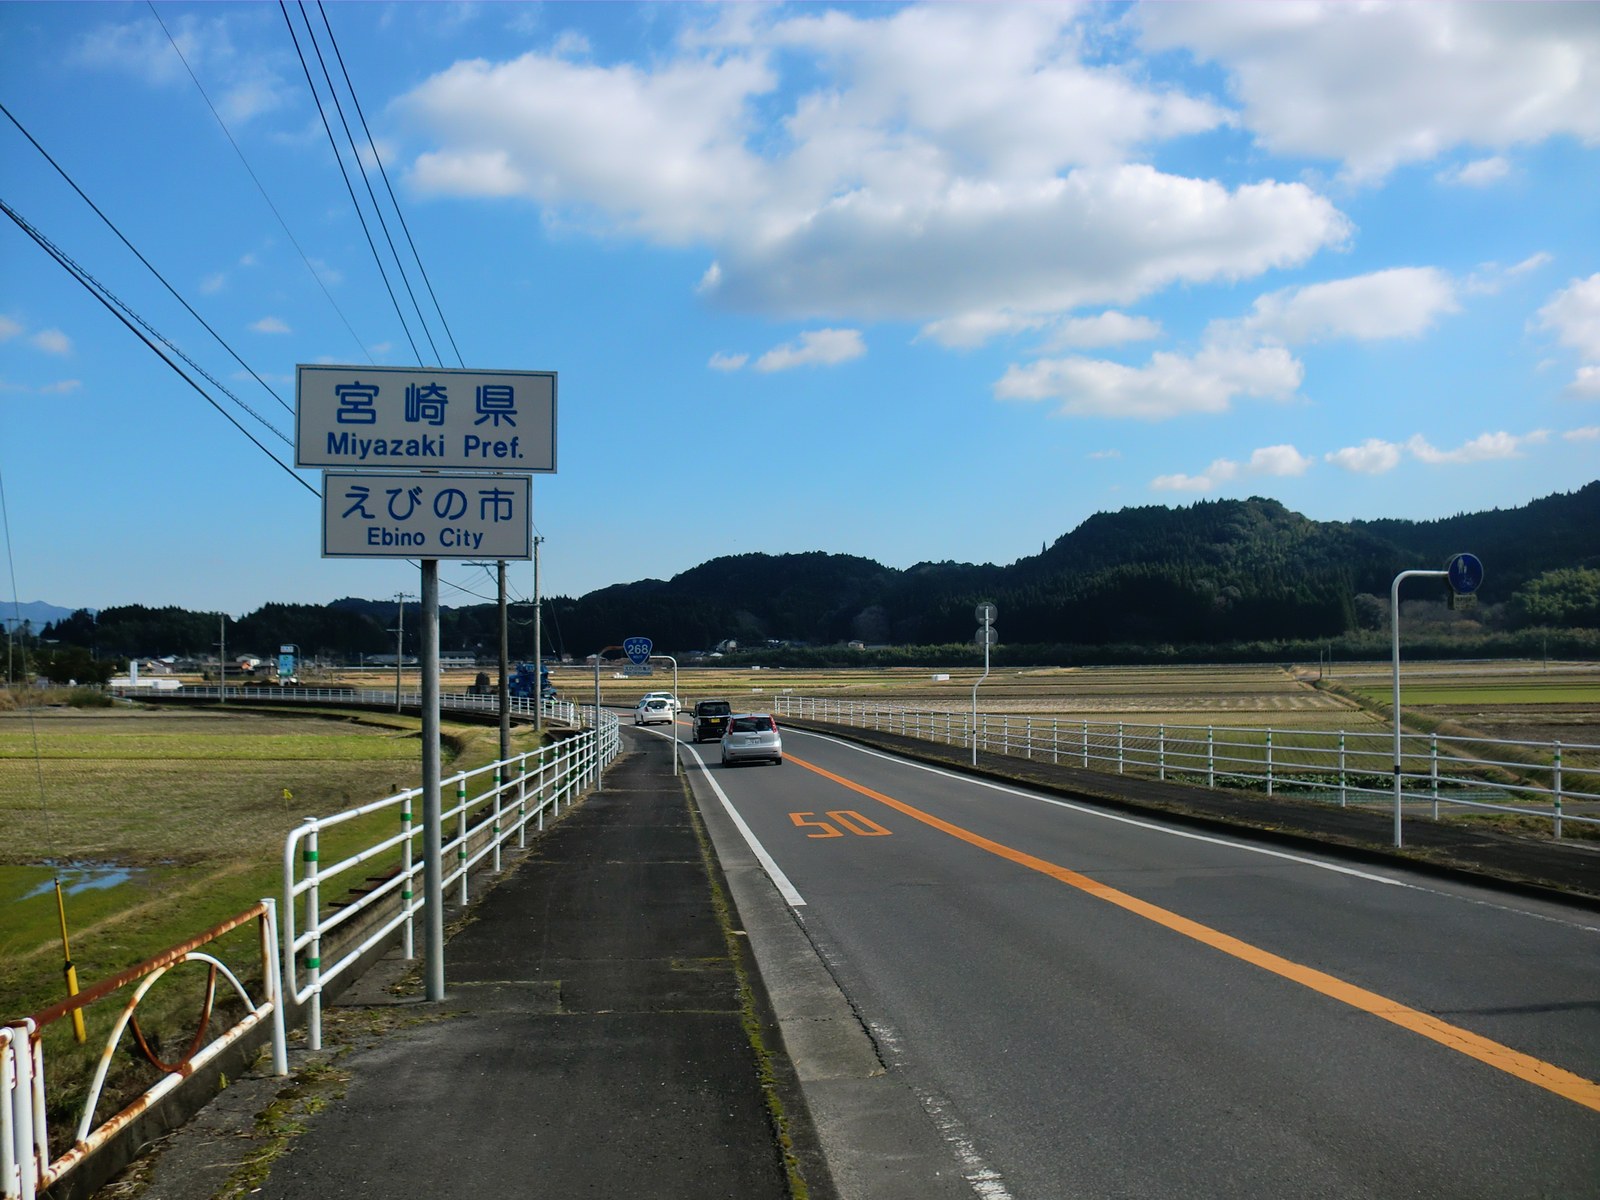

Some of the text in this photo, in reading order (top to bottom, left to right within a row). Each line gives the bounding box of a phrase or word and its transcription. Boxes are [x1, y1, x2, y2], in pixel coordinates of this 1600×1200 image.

[335, 380, 518, 427] 宮崎県
[327, 432, 524, 460] Miyazaki Pref.
[342, 485, 515, 522] えびの市
[367, 527, 484, 550] Ebino City
[628, 644, 649, 655] 268
[788, 810, 893, 838] 50
